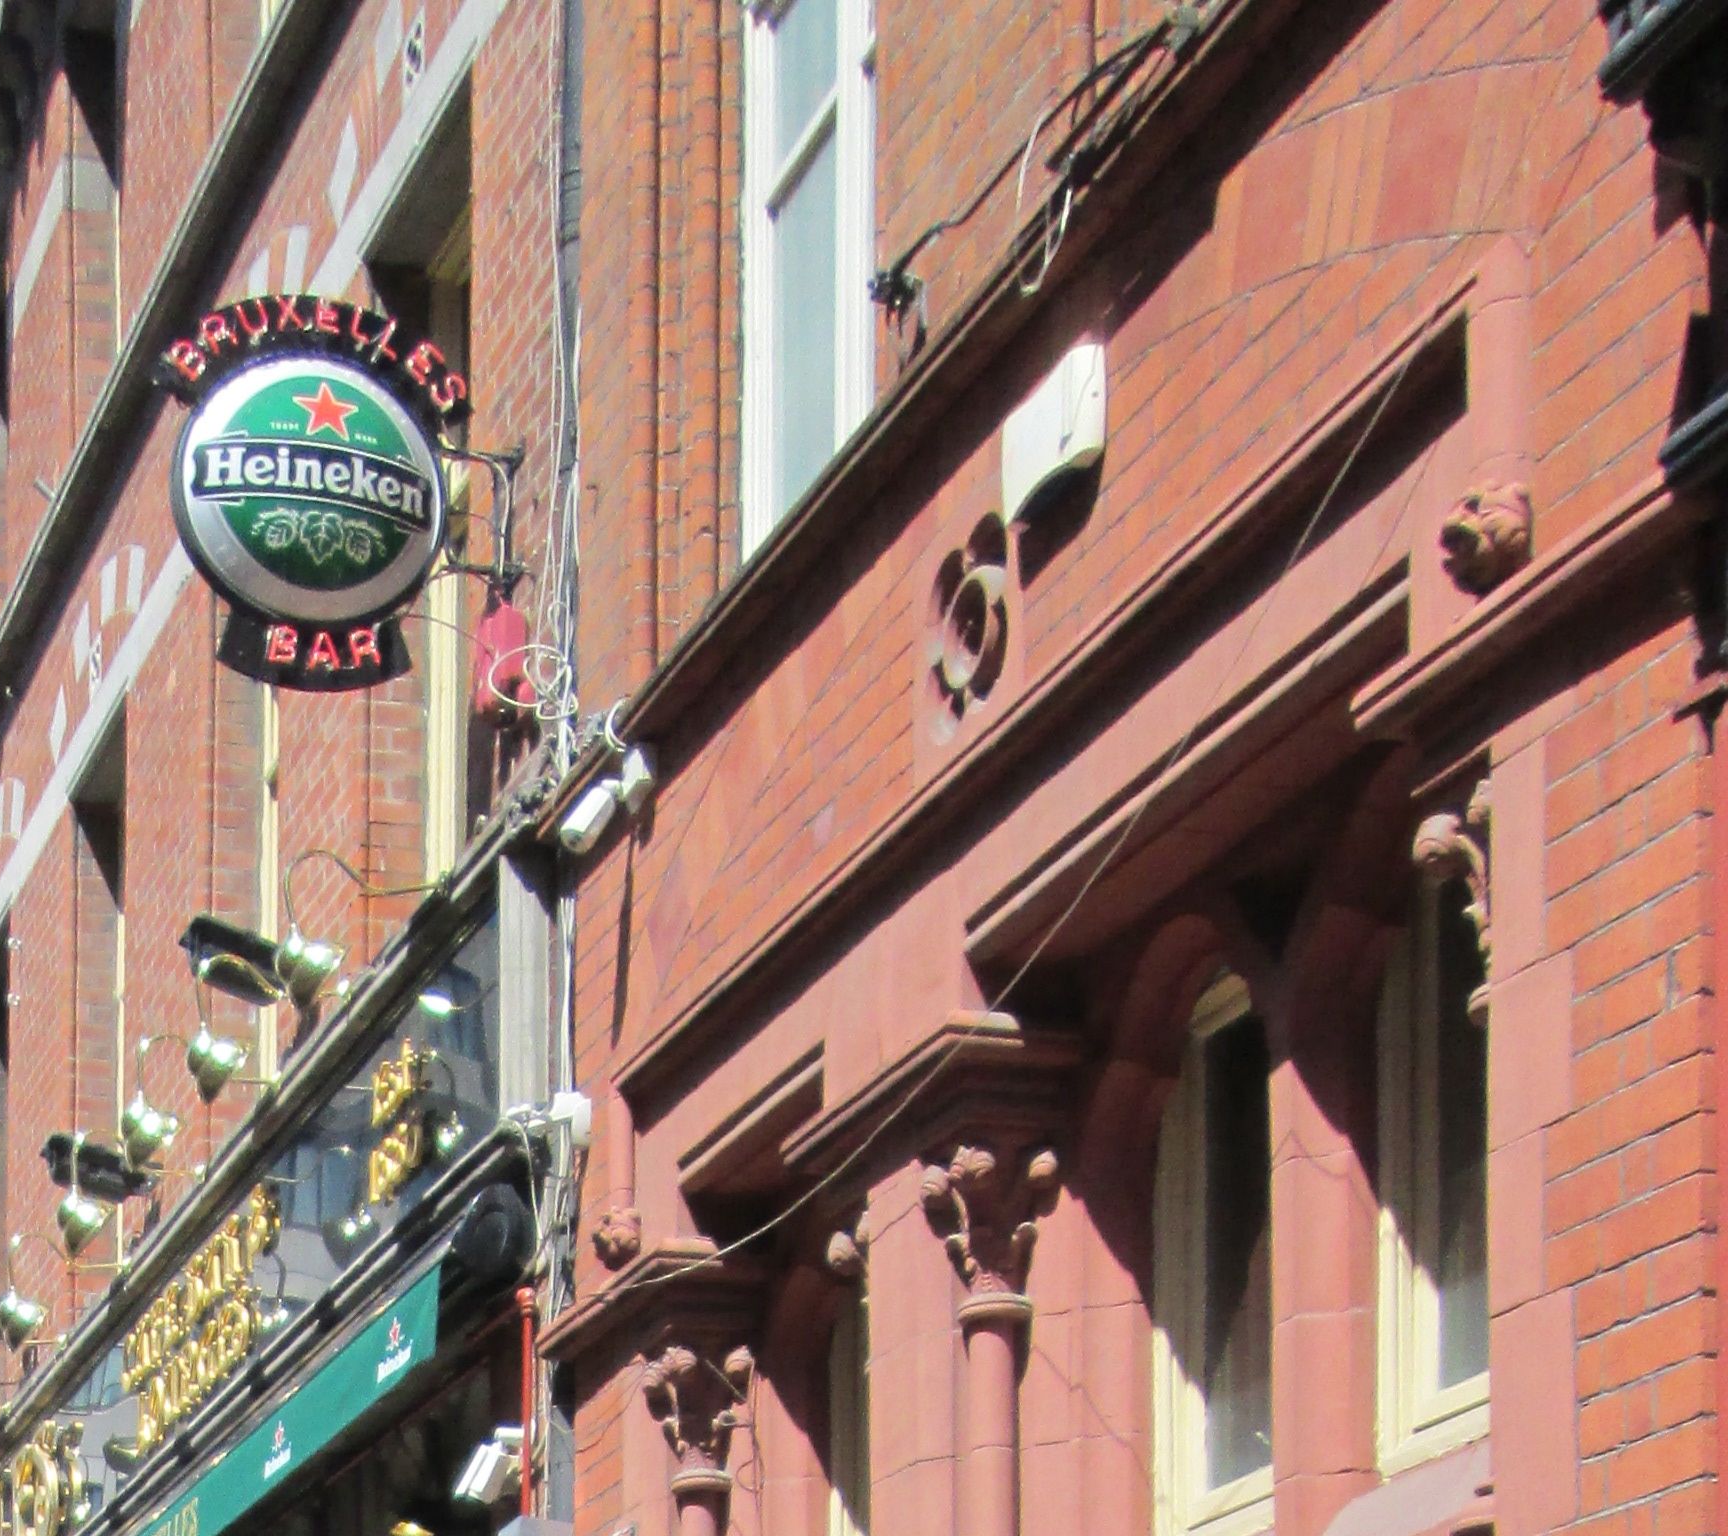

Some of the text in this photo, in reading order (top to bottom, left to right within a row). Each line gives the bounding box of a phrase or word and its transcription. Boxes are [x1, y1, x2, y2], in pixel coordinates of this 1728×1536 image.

[170, 297, 467, 413] BRUXELLES
[204, 448, 425, 518] Heineken
[267, 624, 381, 671] BAR
